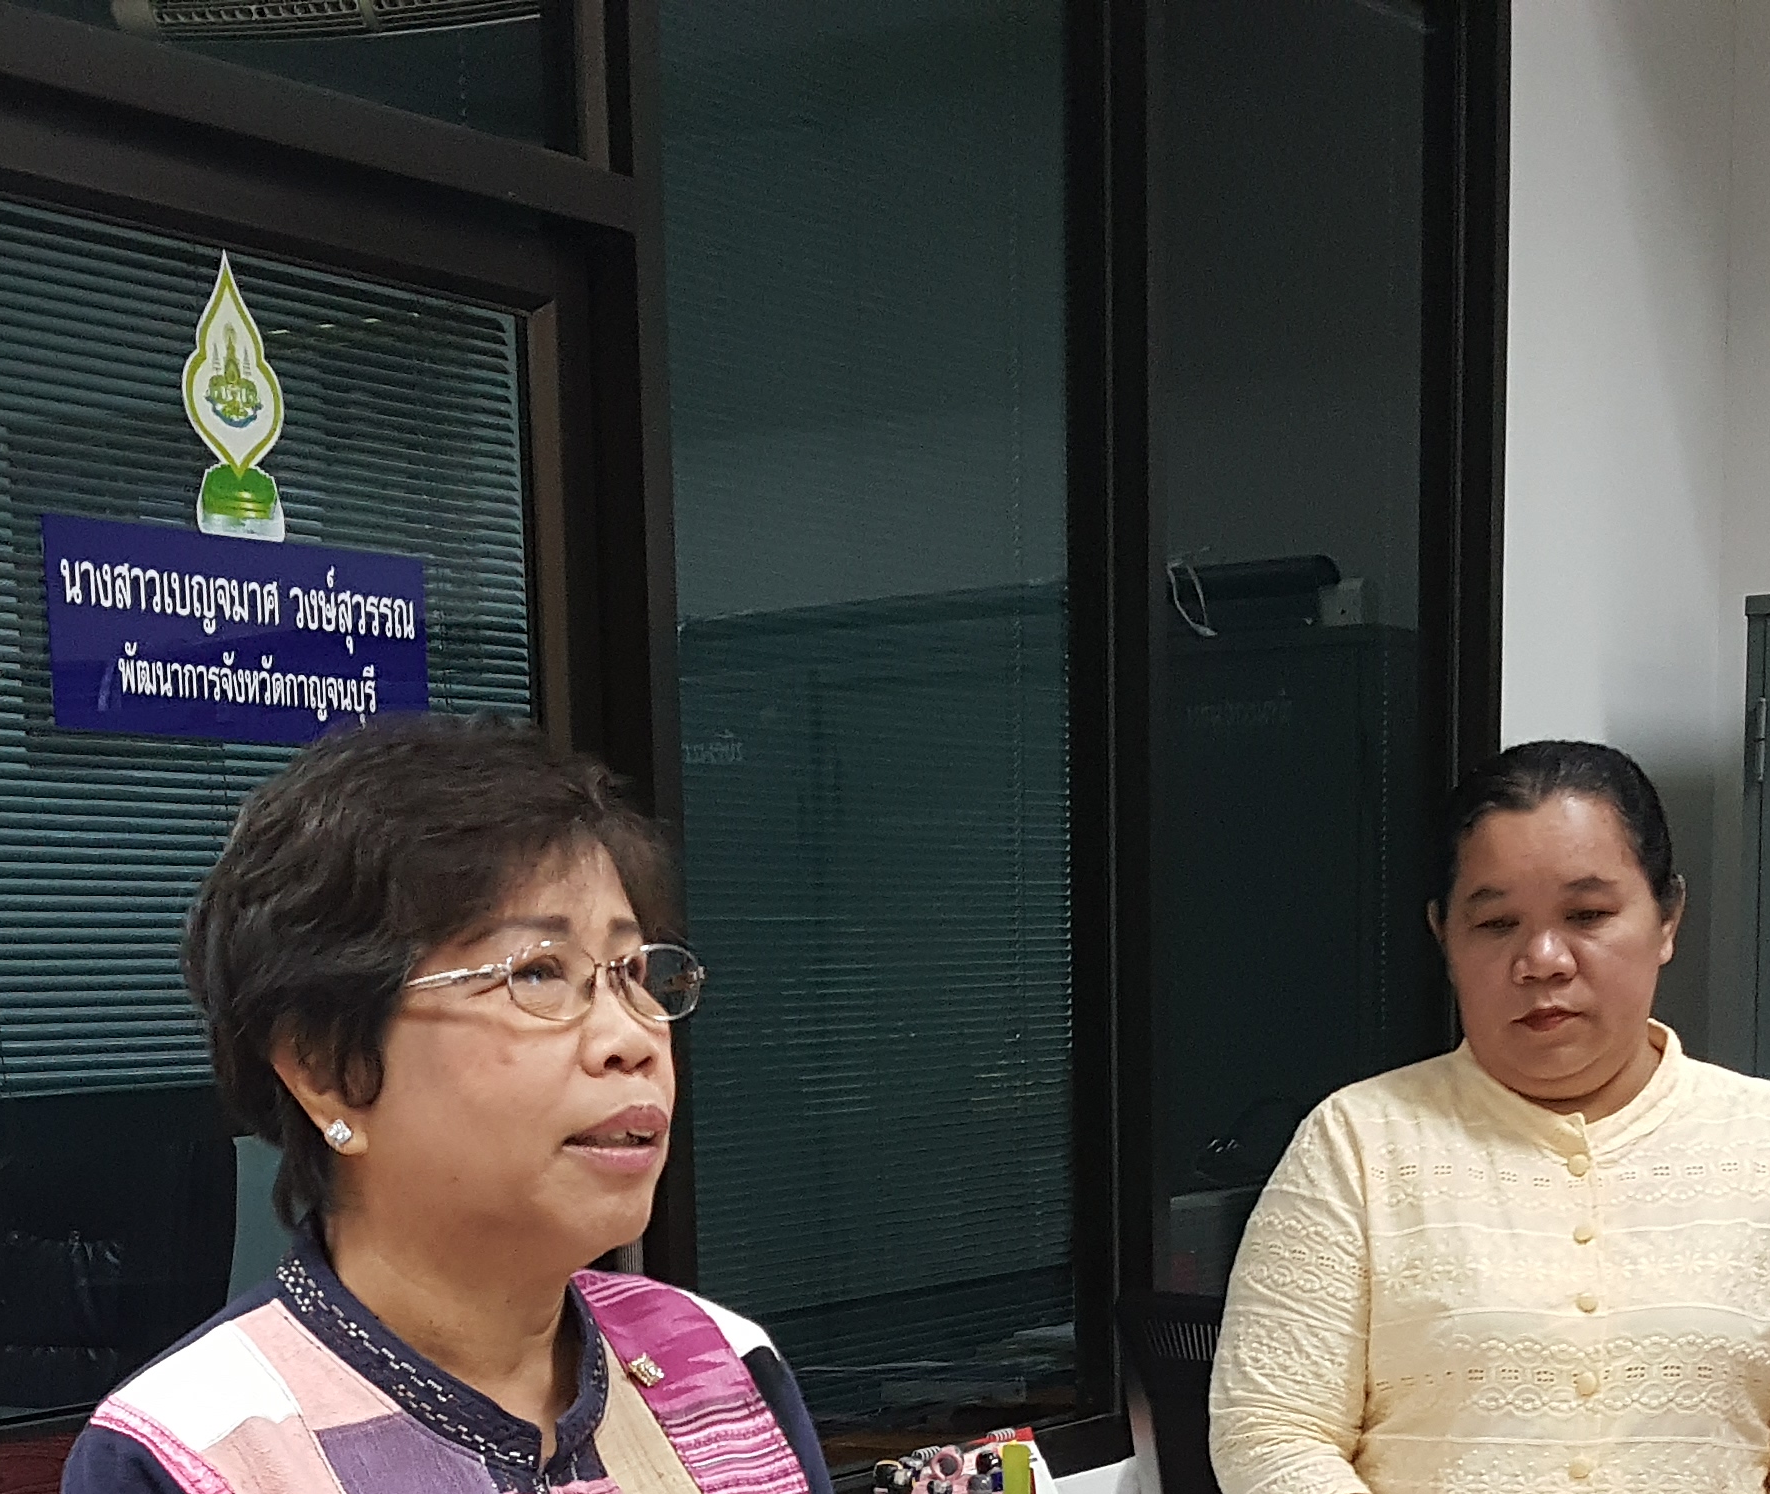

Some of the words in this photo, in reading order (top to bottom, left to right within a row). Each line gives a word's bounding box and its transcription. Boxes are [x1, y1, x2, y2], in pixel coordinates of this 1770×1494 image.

[60, 558, 280, 633] นางสาวเบญจมาศ
[289, 565, 416, 655] วงษ์สุวรรณ
[118, 642, 377, 727] พัฒนาการจังหวัดกาญจนบุรี
